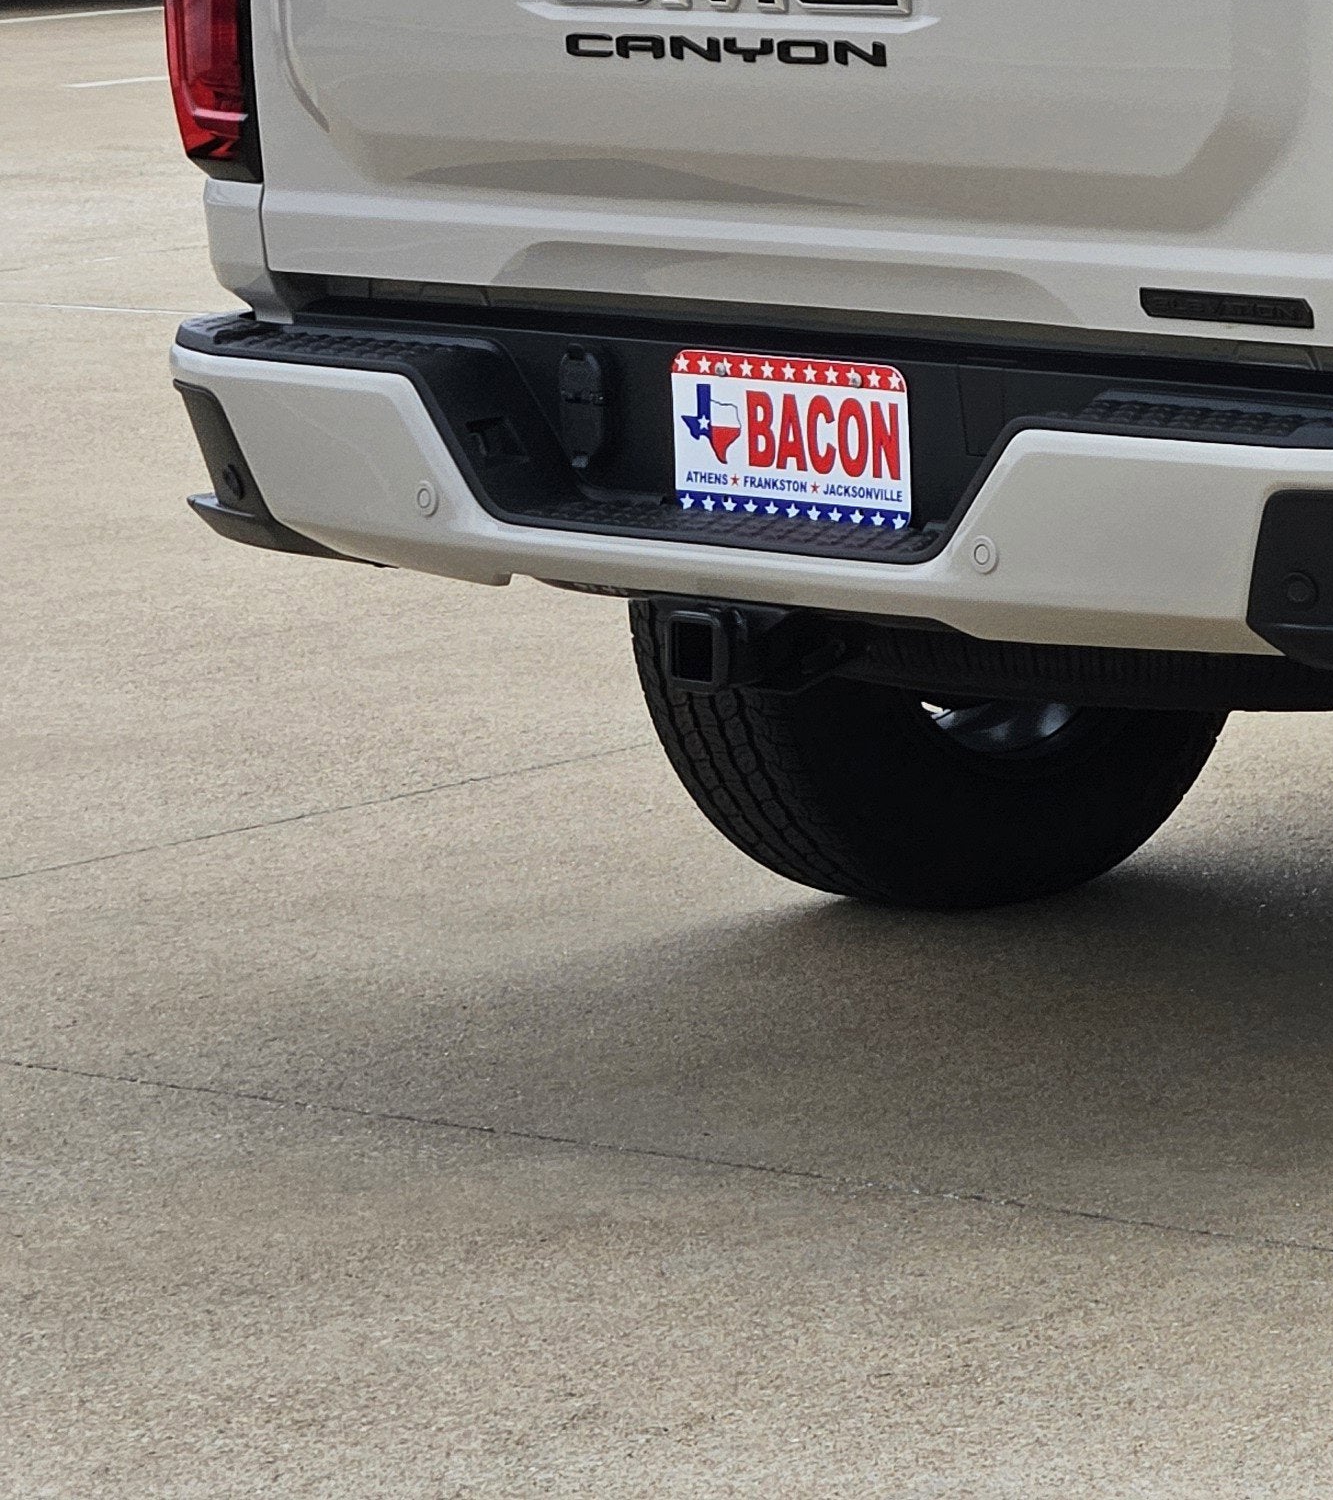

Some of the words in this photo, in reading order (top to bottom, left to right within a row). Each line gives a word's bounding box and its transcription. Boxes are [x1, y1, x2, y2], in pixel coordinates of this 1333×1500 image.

[566, 32, 888, 68] CANYON
[745, 390, 902, 481] BACON
[686, 470, 728, 486] ATHENS
[743, 476, 808, 494] FRANKSTON
[823, 483, 903, 503] JACKSONVILLE
